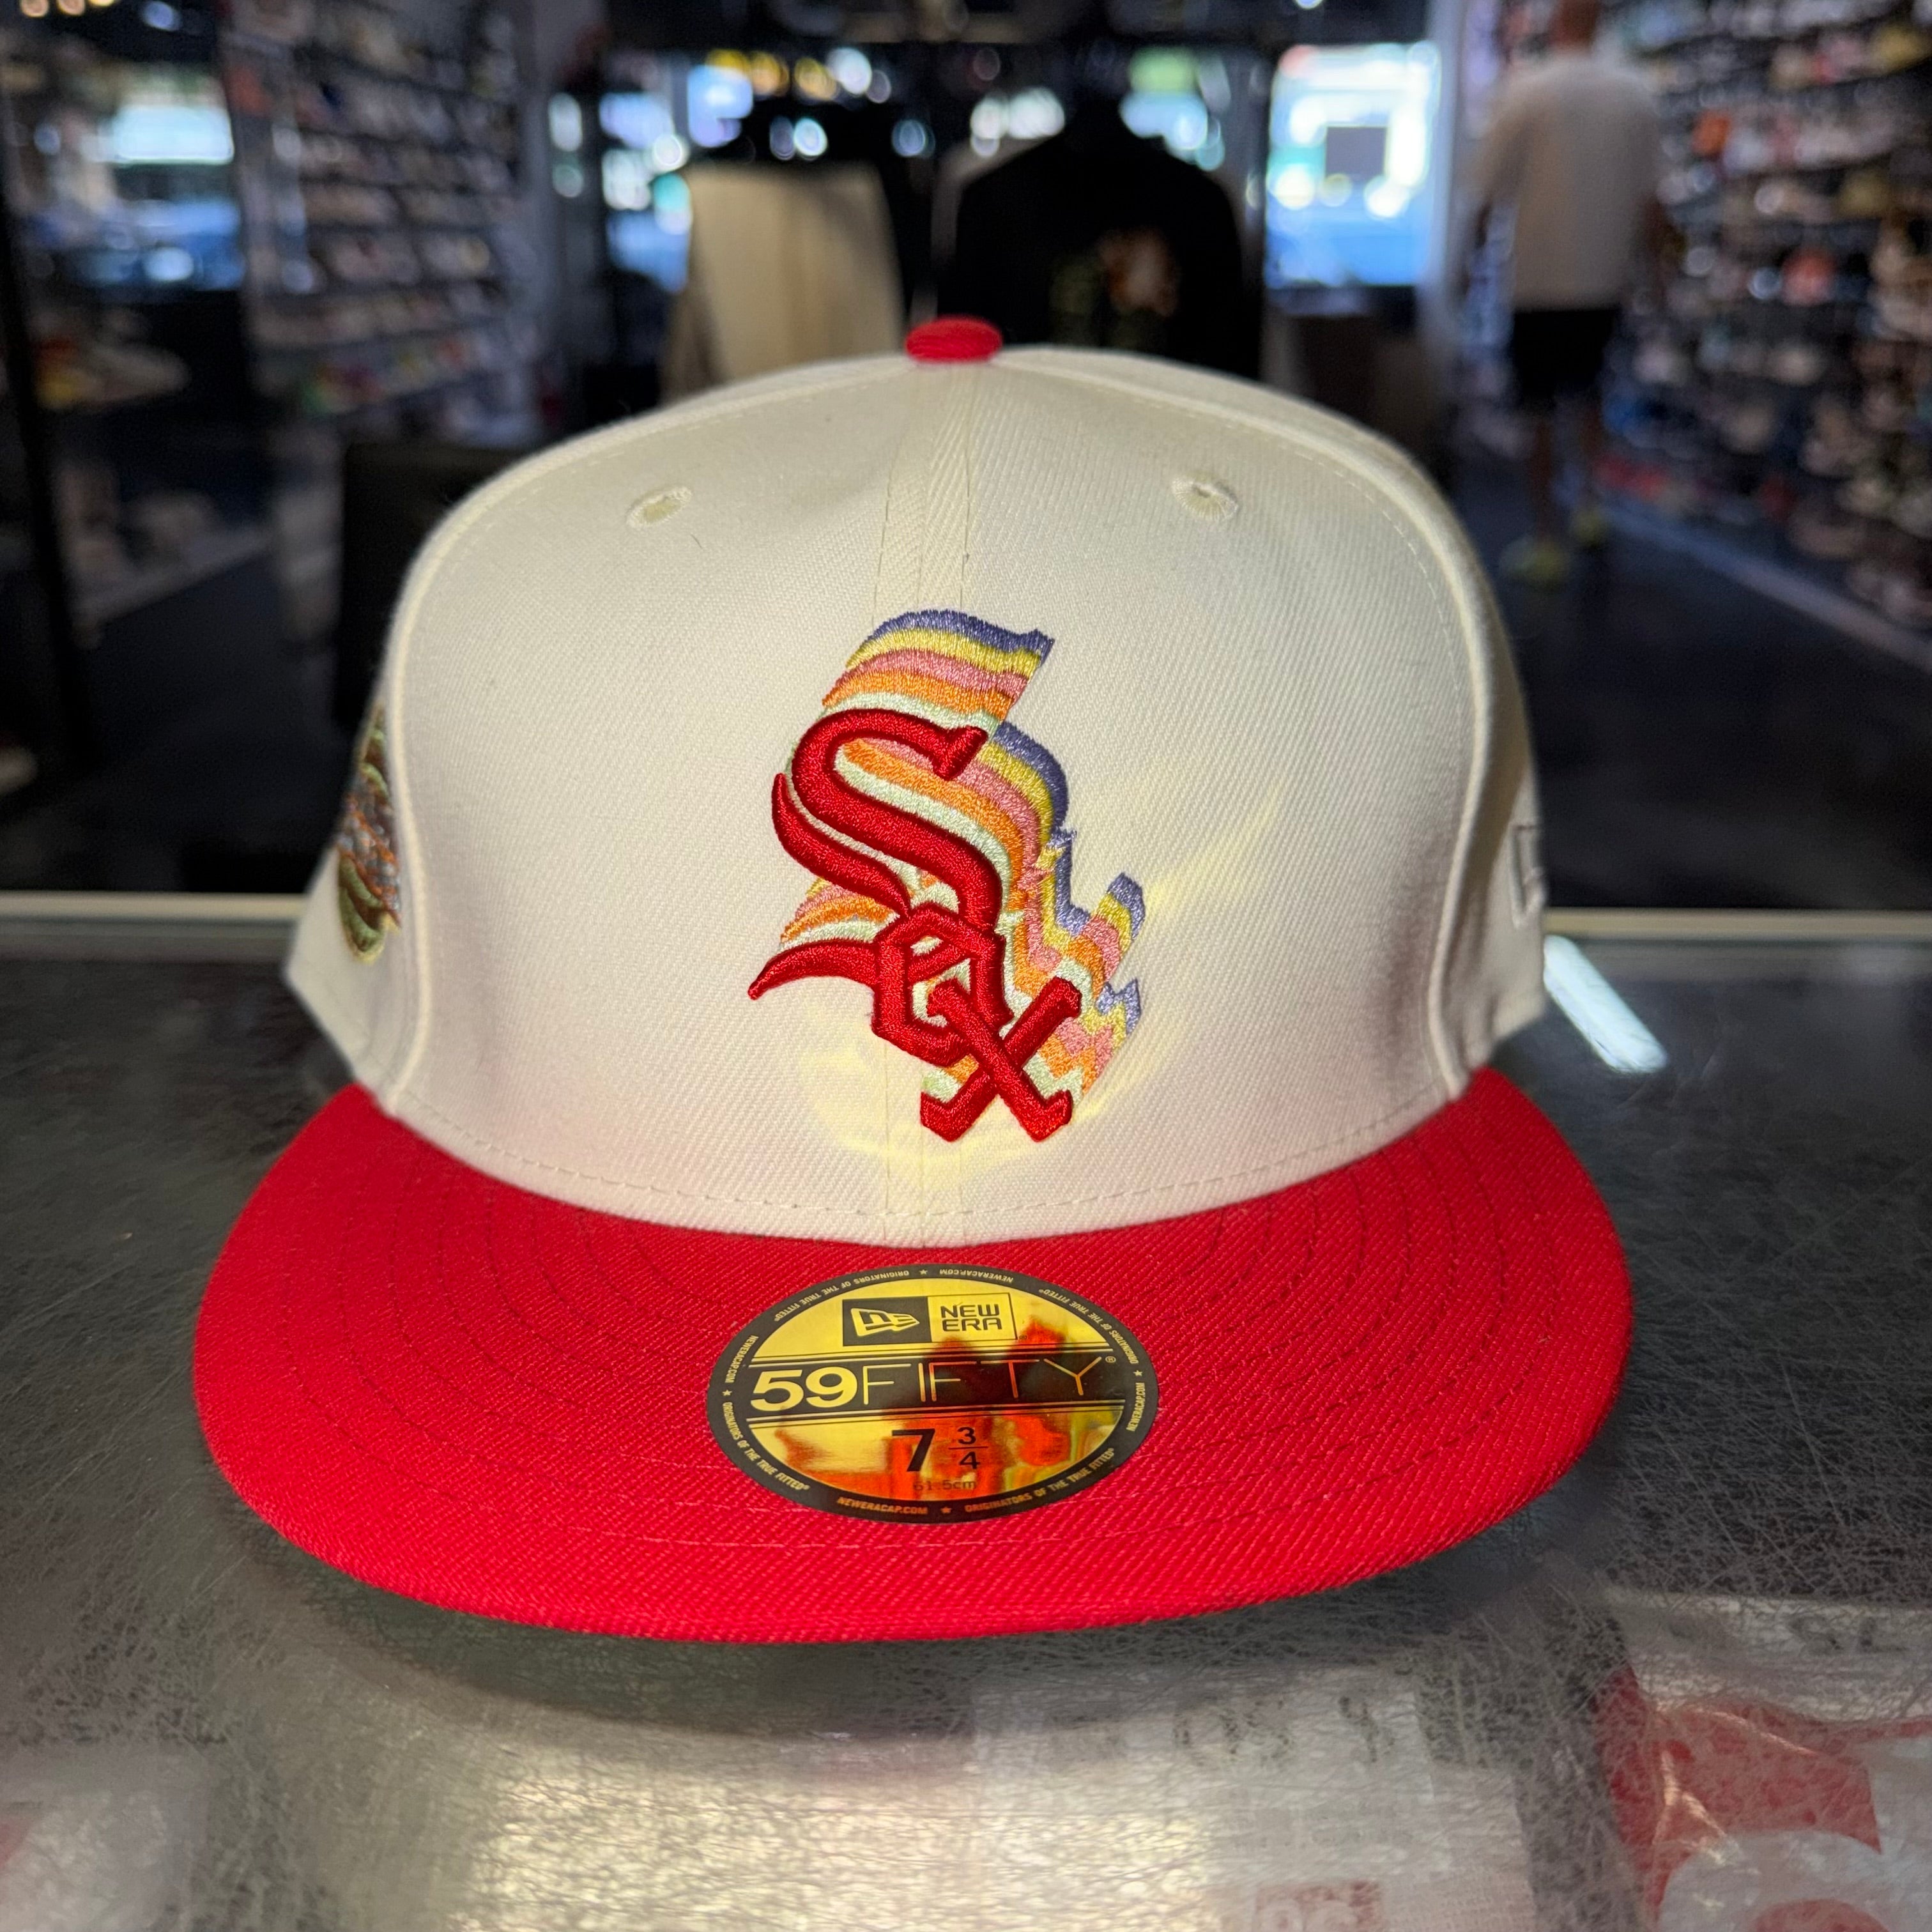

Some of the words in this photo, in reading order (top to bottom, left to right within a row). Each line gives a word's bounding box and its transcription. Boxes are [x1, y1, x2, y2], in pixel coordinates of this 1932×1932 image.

[854, 1270, 909, 1285] ORIGINATORS
[939, 1269, 1014, 1283] NEWERACAP.COM
[823, 1285, 839, 1296] THE
[841, 1281, 851, 1289] OF
[801, 1292, 822, 1305] TRUE
[940, 1303, 1000, 1319] NEW
[1070, 1301, 1089, 1315] TRUE
[942, 1317, 1002, 1332] ERA
[1087, 1312, 1104, 1324] THE
[1101, 1322, 1112, 1331] OF
[1109, 1330, 1139, 1364] ORIGINATORS
[724, 1335, 759, 1383] NEWERACAP.COM
[1126, 1383, 1146, 1432] NEWERACAP.COM
[723, 1402, 743, 1440] ORIGINATORS
[737, 1440, 750, 1448] OF
[744, 1448, 761, 1461] THE
[757, 1459, 778, 1475] TRUE
[958, 1427, 977, 1445] 3
[892, 1429, 935, 1471] 7
[960, 1452, 981, 1469] 4
[964, 1492, 1033, 1512] ORIGINATORS
[1034, 1487, 1046, 1497] OF
[1047, 1480, 1069, 1491] THE
[1067, 1468, 1091, 1482] TRUE
[837, 1496, 928, 1514] NEWERACAP.COM
